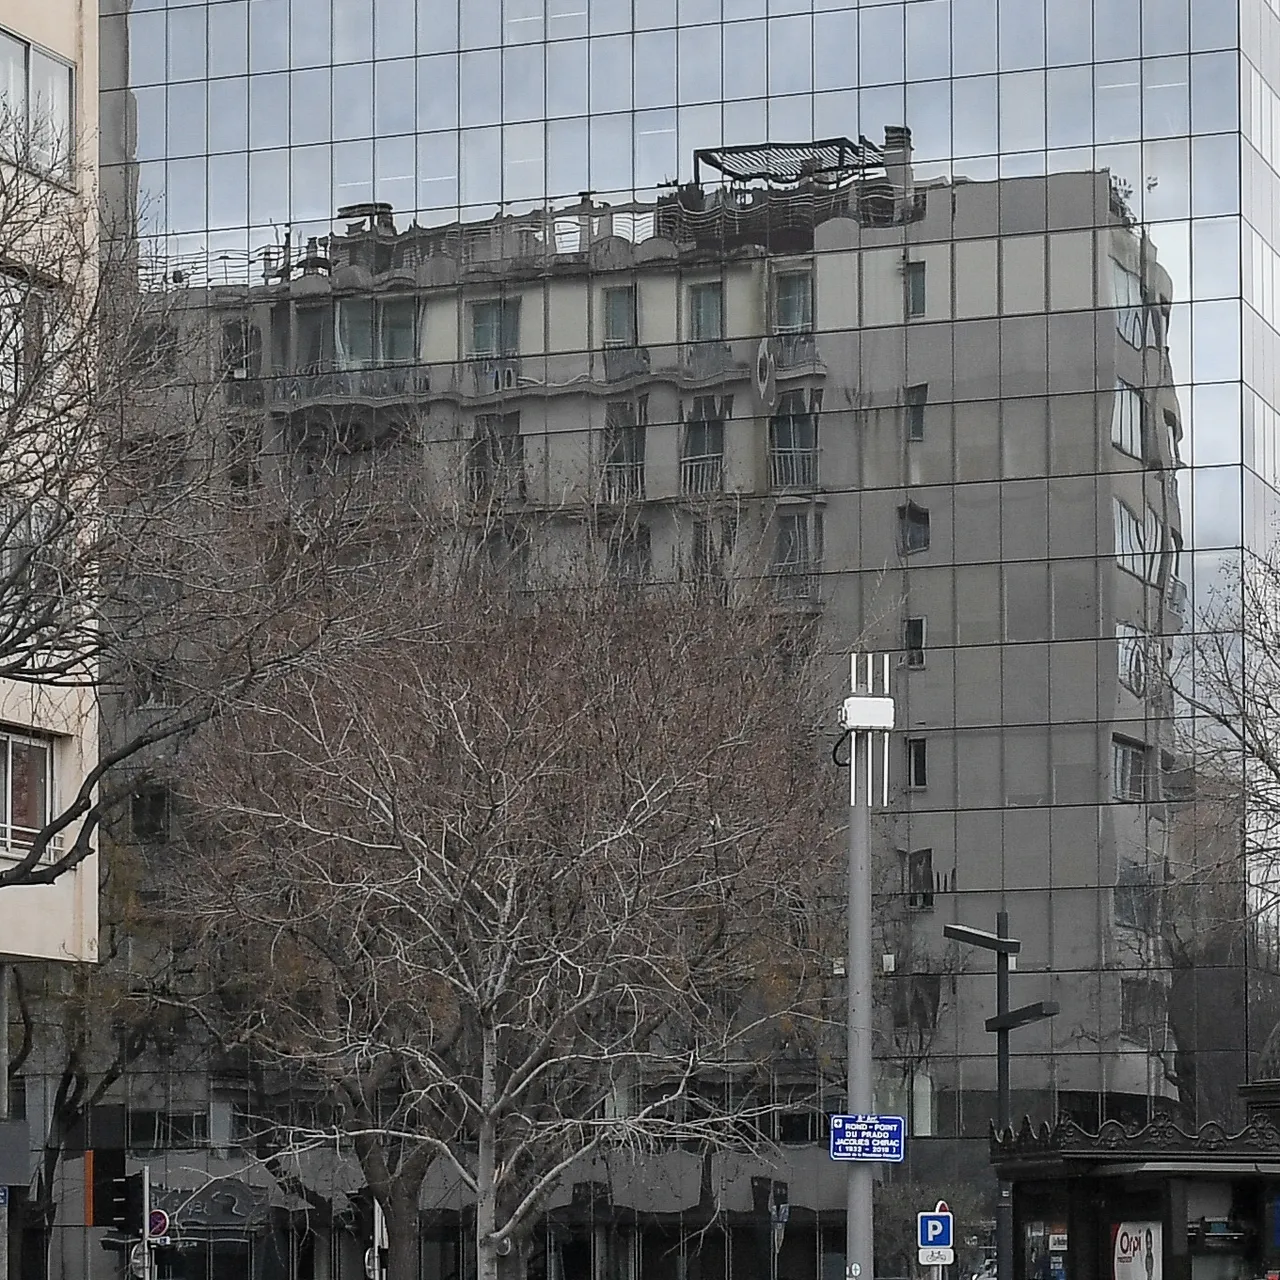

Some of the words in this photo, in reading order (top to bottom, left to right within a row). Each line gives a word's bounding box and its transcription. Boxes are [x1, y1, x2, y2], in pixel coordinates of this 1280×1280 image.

[845, 1123, 868, 1131] ROND
[874, 1123, 898, 1132] POINT
[861, 1131, 890, 1139] PRADO
[835, 1138, 870, 1146] JACQUES
[872, 1139, 900, 1147] CHIRAC
[927, 1220, 943, 1241] P
[1120, 1229, 1142, 1258] Orpi
